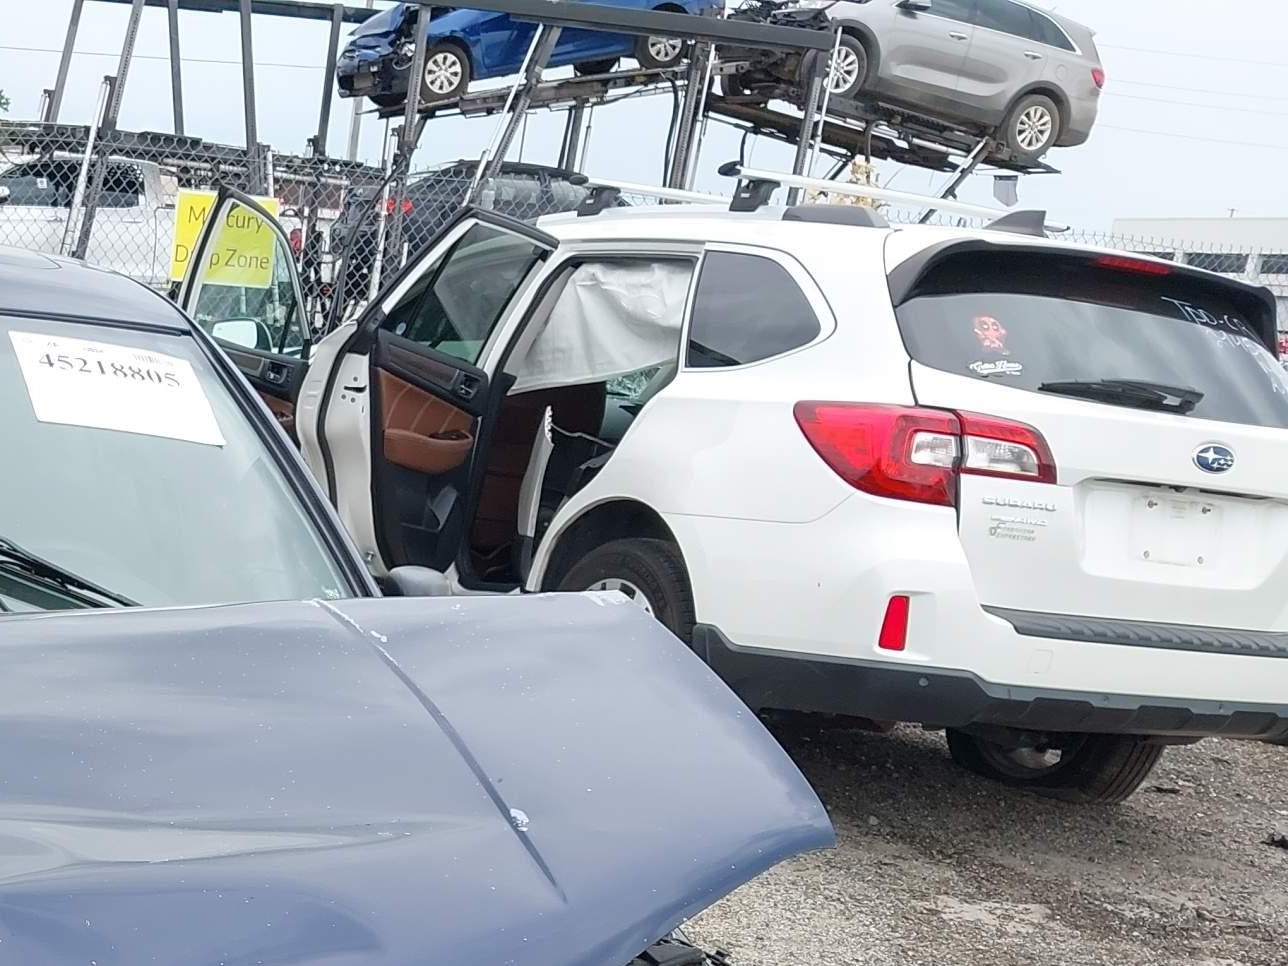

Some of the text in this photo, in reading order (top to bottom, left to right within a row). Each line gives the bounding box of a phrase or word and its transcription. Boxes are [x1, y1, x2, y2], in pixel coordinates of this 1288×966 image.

[188, 204, 264, 234] Mcury
[174, 244, 270, 270] Dp Zone
[38, 353, 182, 388] 45218805
[982, 496, 1057, 512] SUBARU
